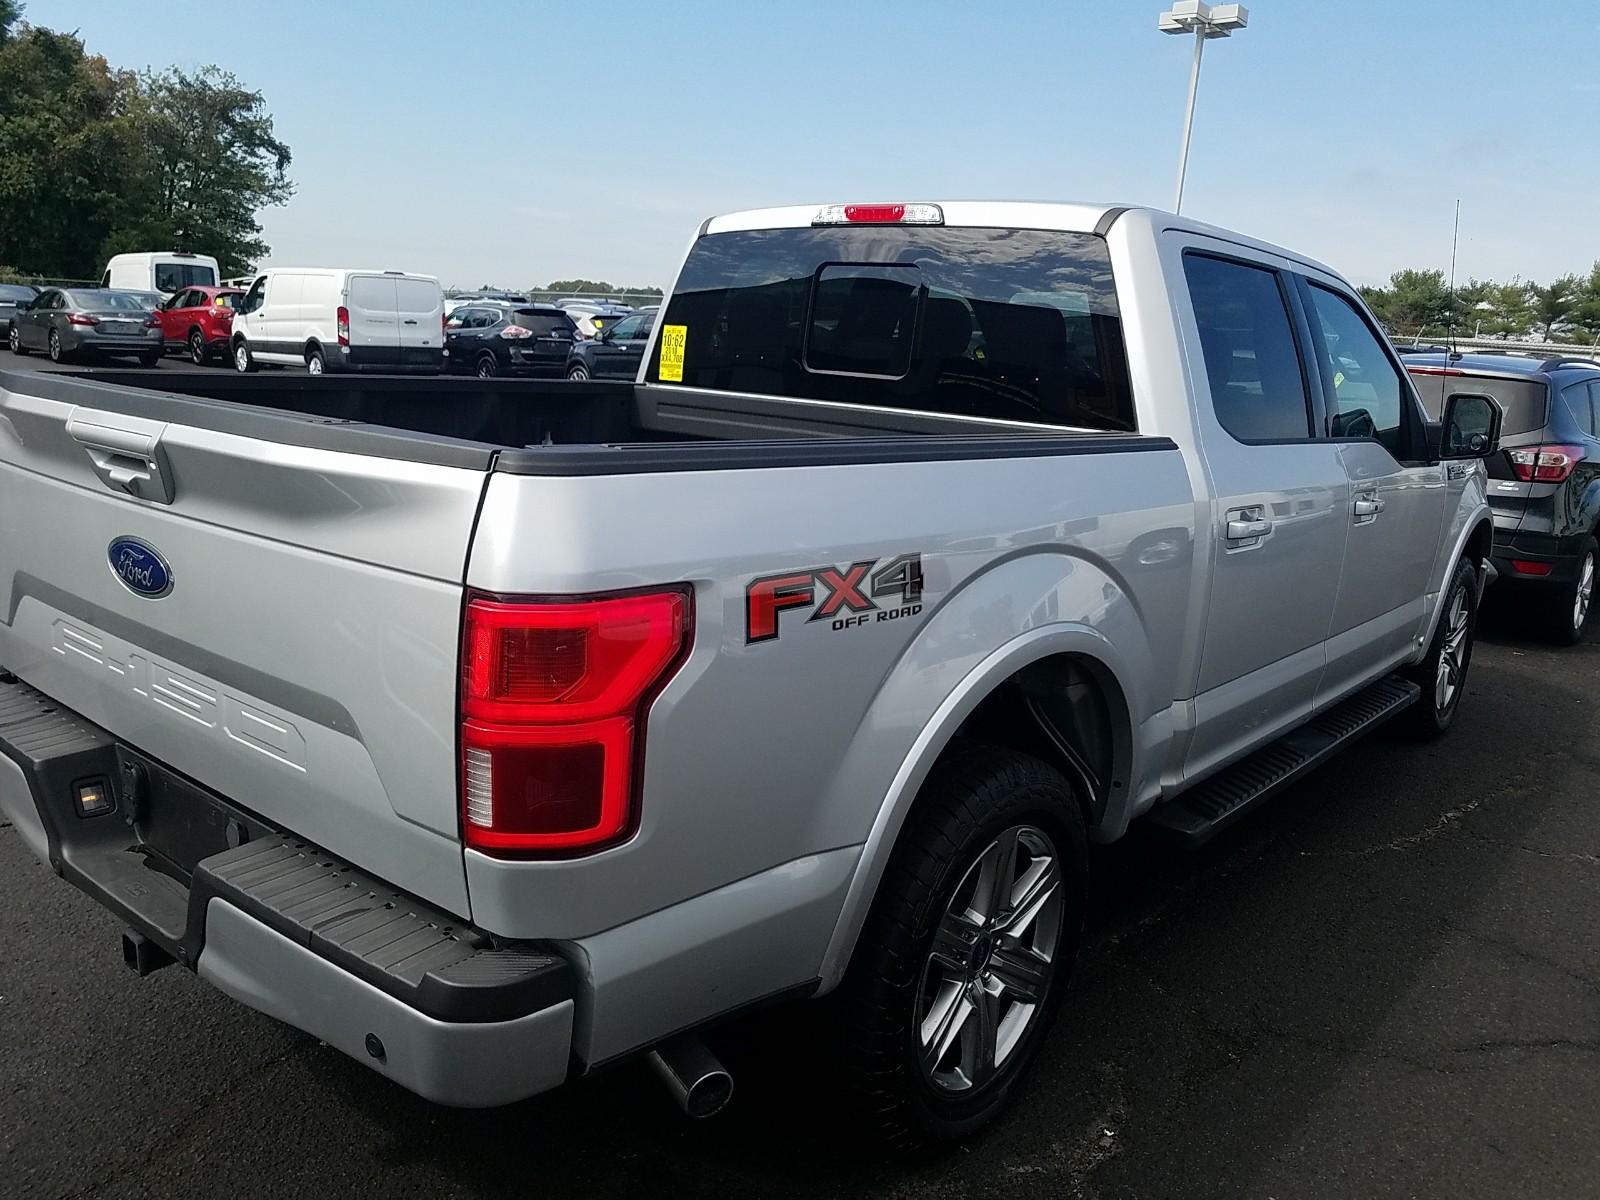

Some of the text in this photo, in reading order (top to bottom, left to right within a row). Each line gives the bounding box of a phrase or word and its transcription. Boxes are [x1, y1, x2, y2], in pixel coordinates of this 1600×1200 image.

[118, 548, 154, 587] Ford
[744, 552, 924, 646] FX4
[832, 604, 922, 631] OFF ROAD
[51, 618, 307, 773] F-150
